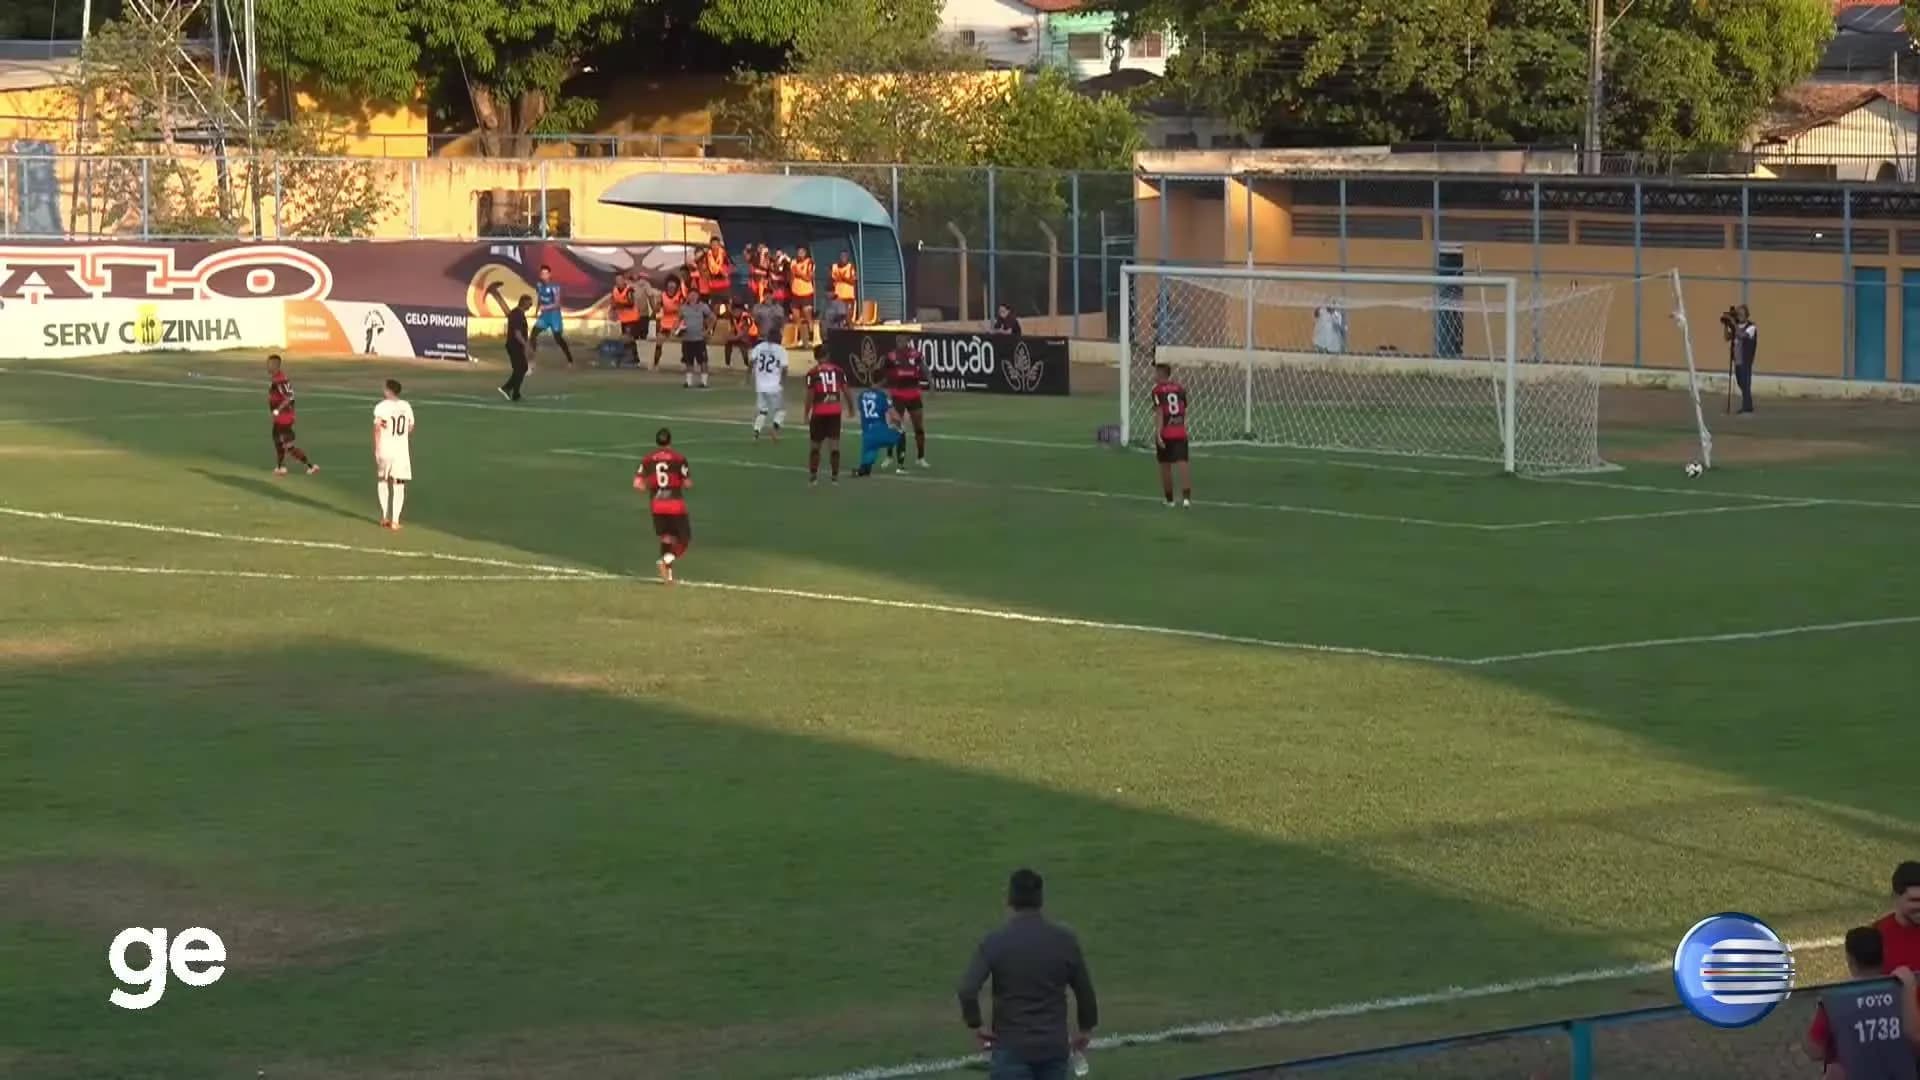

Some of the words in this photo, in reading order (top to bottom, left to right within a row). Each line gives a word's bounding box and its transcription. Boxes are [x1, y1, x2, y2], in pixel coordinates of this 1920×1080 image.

[405, 312, 428, 326] GELO
[429, 313, 466, 329] PINGUIM
[43, 321, 110, 347] SERV
[758, 353, 775, 373] 32
[819, 371, 837, 392] 14
[933, 377, 966, 390] ADARIA
[861, 399, 880, 419] 12
[1167, 393, 1180, 415] 8
[390, 415, 406, 437] 10
[656, 462, 670, 488] 6
[1856, 994, 1893, 1009] FOTO
[1854, 1016, 1901, 1043] 1738
